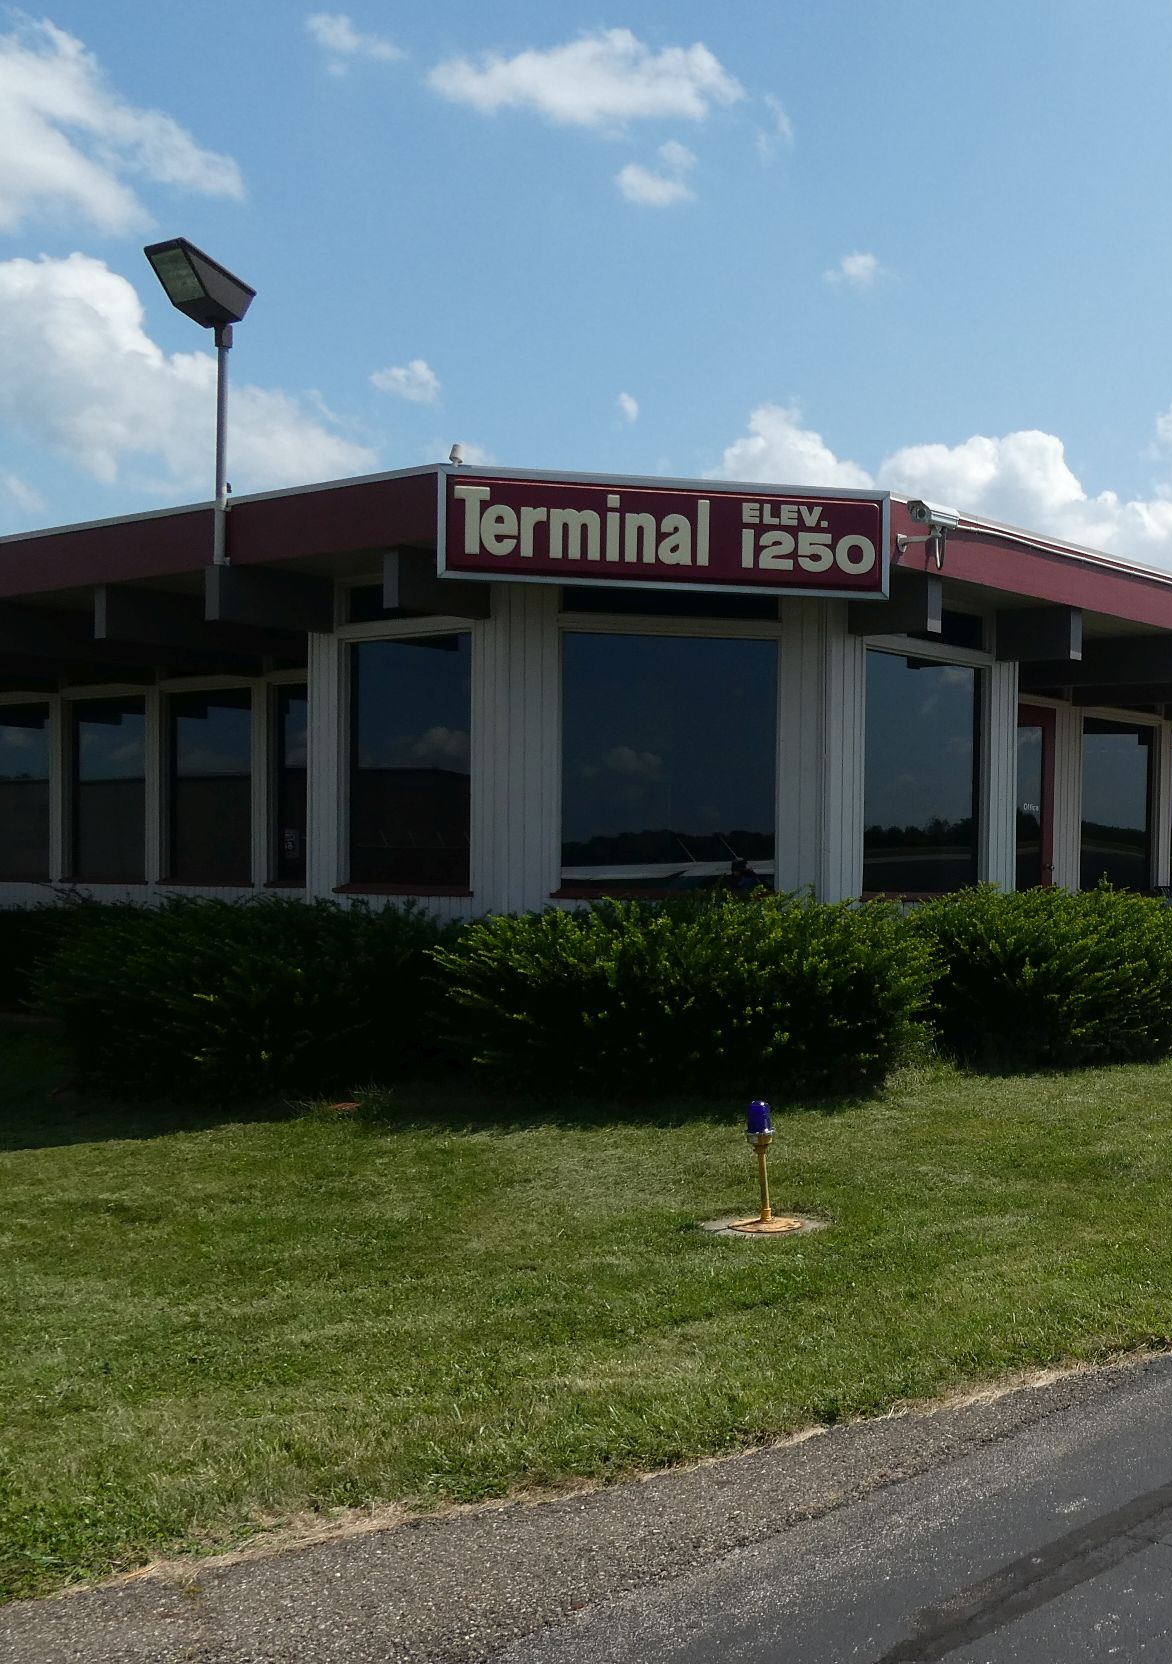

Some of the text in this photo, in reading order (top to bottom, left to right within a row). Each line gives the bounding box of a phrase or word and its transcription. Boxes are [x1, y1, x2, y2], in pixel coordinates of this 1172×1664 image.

[454, 485, 710, 567] Terminal
[741, 502, 829, 528] ELEV.
[741, 528, 876, 575] 1250
